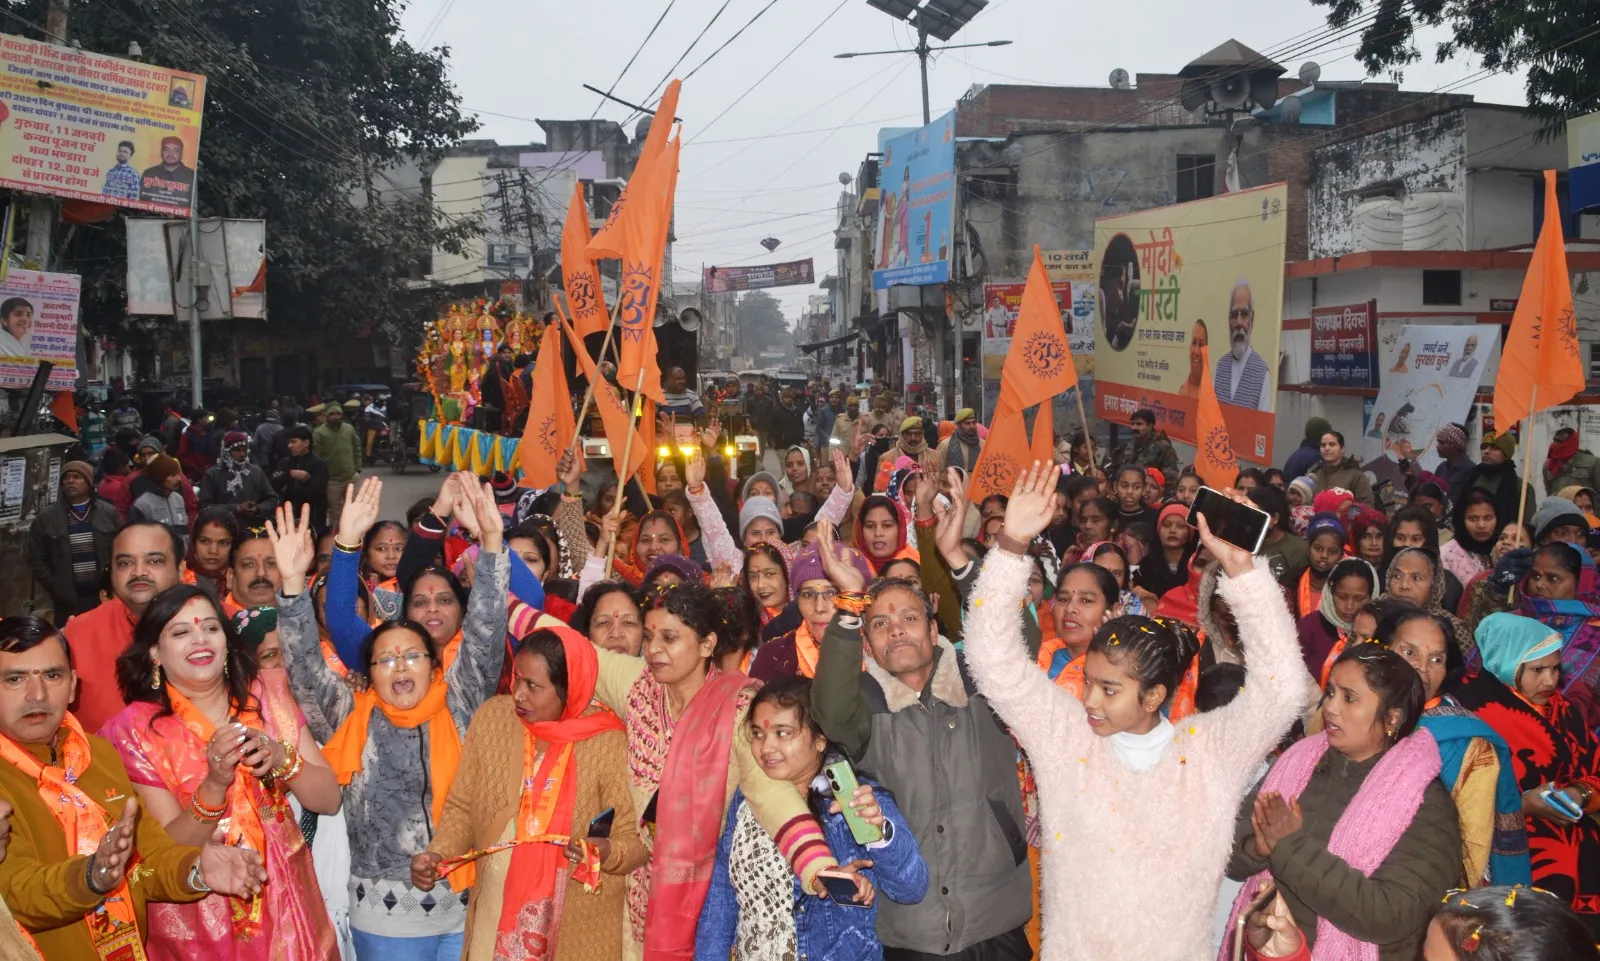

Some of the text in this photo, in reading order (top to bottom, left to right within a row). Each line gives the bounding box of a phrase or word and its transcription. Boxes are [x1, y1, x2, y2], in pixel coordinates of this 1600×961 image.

[4, 40, 38, 54] बालाजी
[127, 66, 151, 79] दरबार
[34, 58, 64, 71] महाराज
[66, 64, 76, 74] का
[78, 65, 100, 80] तीसरा
[146, 83, 168, 93] दरबार
[35, 70, 52, 79] आप
[54, 74, 70, 83] सभी
[90, 82, 108, 92] सादर
[12, 104, 34, 114] दरबार
[39, 97, 54, 107] दिन
[93, 109, 122, 121] बालाजी
[124, 114, 133, 122] का
[23, 131, 97, 152] कन्या पूजन एवं
[71, 127, 106, 142] जनवरी
[29, 145, 87, 163] भव्य भण्डारा
[11, 153, 100, 178] दोपहर 12.00 बजे
[22, 168, 32, 178] से
[65, 175, 89, 188] होगा
[1134, 226, 1174, 277] मोदी
[1343, 307, 1367, 331] दिवस
[1414, 354, 1436, 370] सुरक्षा
[1103, 394, 1119, 412] हमारा
[1120, 393, 1139, 415] संकल्प
